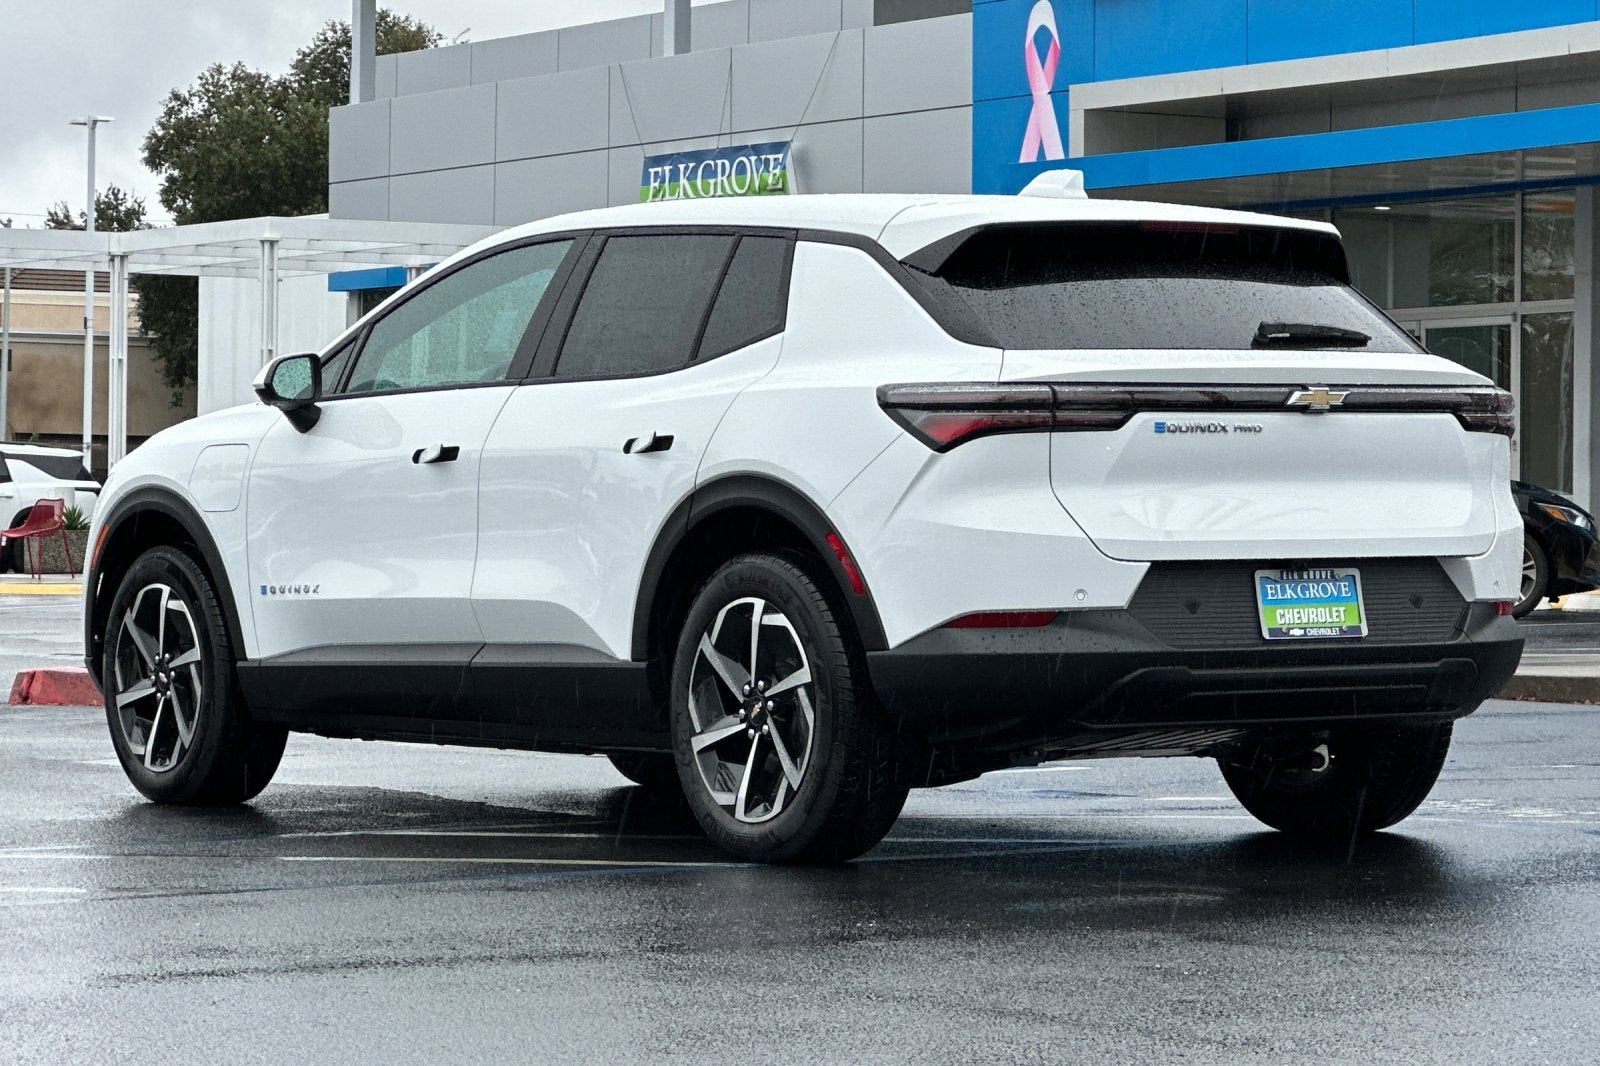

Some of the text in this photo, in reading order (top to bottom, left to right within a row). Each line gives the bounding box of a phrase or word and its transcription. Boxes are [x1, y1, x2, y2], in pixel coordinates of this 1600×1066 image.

[1154, 421, 1229, 434] EQUINOX
[1303, 570, 1332, 580] GROVE
[260, 584, 320, 595] EQUINOX
[1276, 606, 1347, 625] CHEVROLET
[1305, 627, 1341, 637] CHEVROLET
